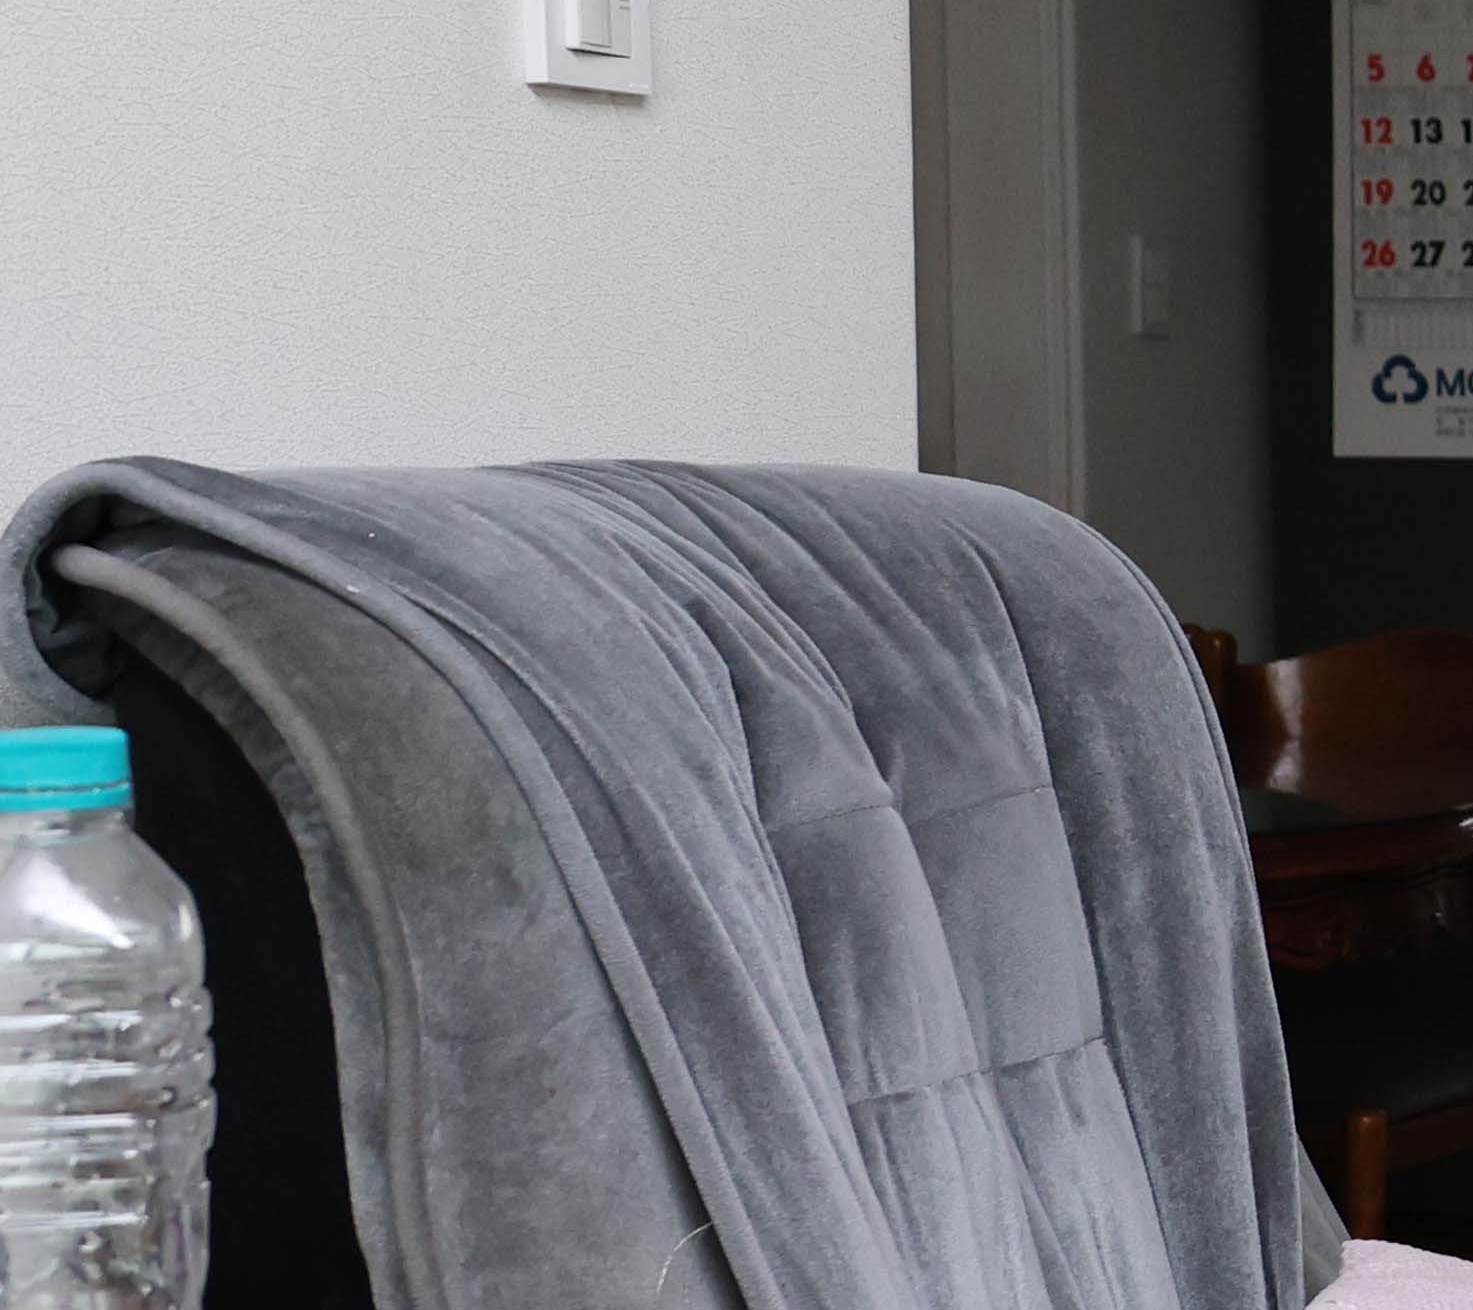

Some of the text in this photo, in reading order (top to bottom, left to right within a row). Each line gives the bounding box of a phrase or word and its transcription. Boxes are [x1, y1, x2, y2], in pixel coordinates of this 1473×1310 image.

[1367, 53, 1385, 84] 5
[1416, 54, 1436, 83] 6
[1361, 117, 1393, 145] 12
[1410, 116, 1444, 145] 13
[1361, 178, 1394, 206] 19
[1410, 178, 1447, 207] 20
[1361, 239, 1396, 268] 26
[1410, 240, 1446, 268] 27
